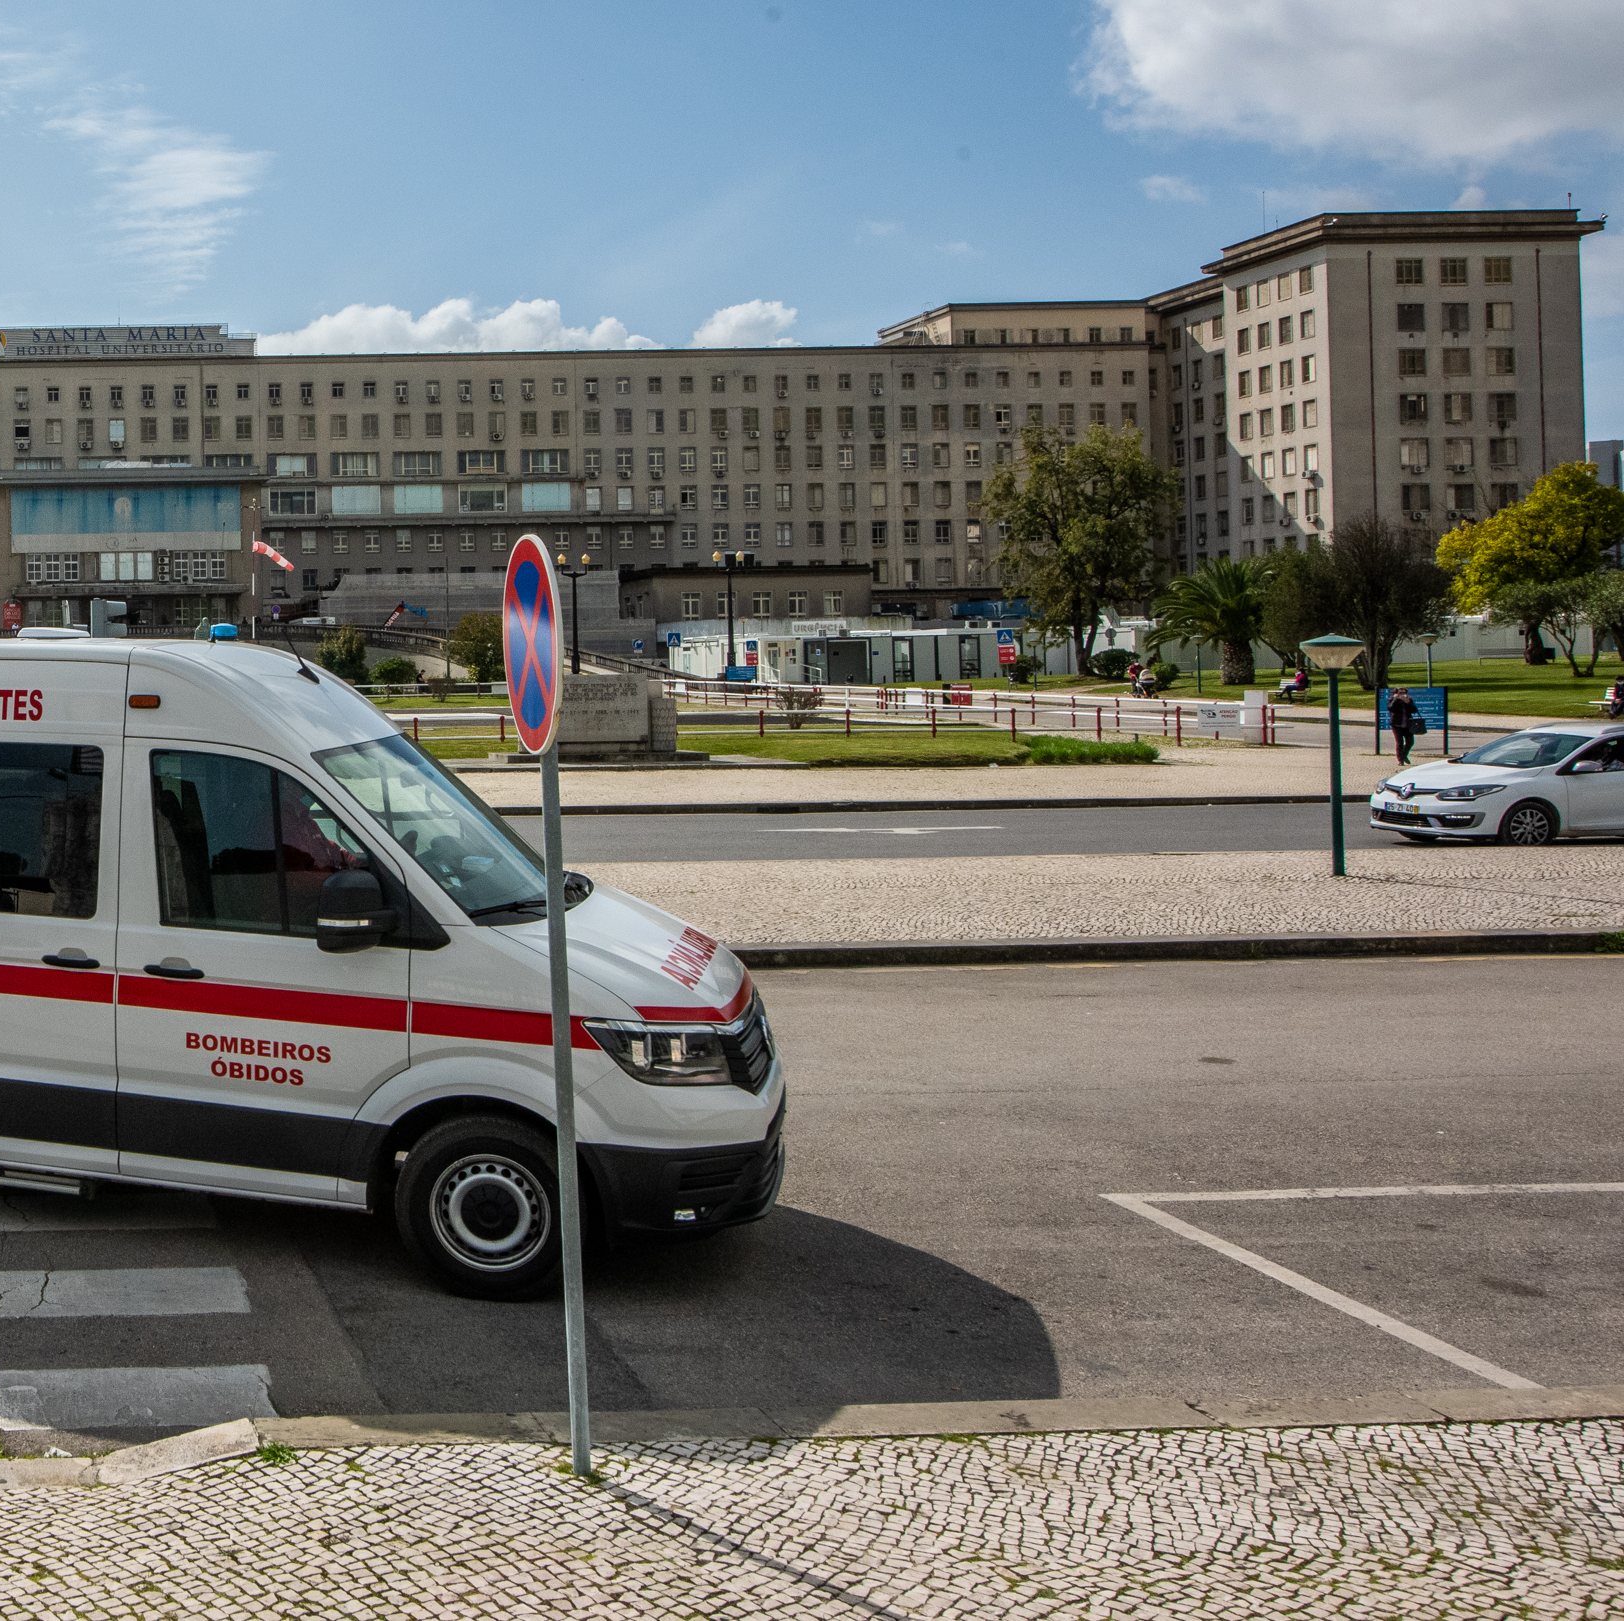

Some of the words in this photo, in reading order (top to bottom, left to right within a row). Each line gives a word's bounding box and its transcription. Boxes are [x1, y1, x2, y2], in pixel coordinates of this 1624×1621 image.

[32, 327, 107, 343] SANTA
[127, 326, 206, 342] MARIA
[16, 345, 91, 356] HOSPITAL
[101, 342, 224, 355] UNIVERSITÁRIO
[185, 1032, 332, 1063] BOMBEIROS
[210, 1056, 304, 1086] ÓBIDOS
